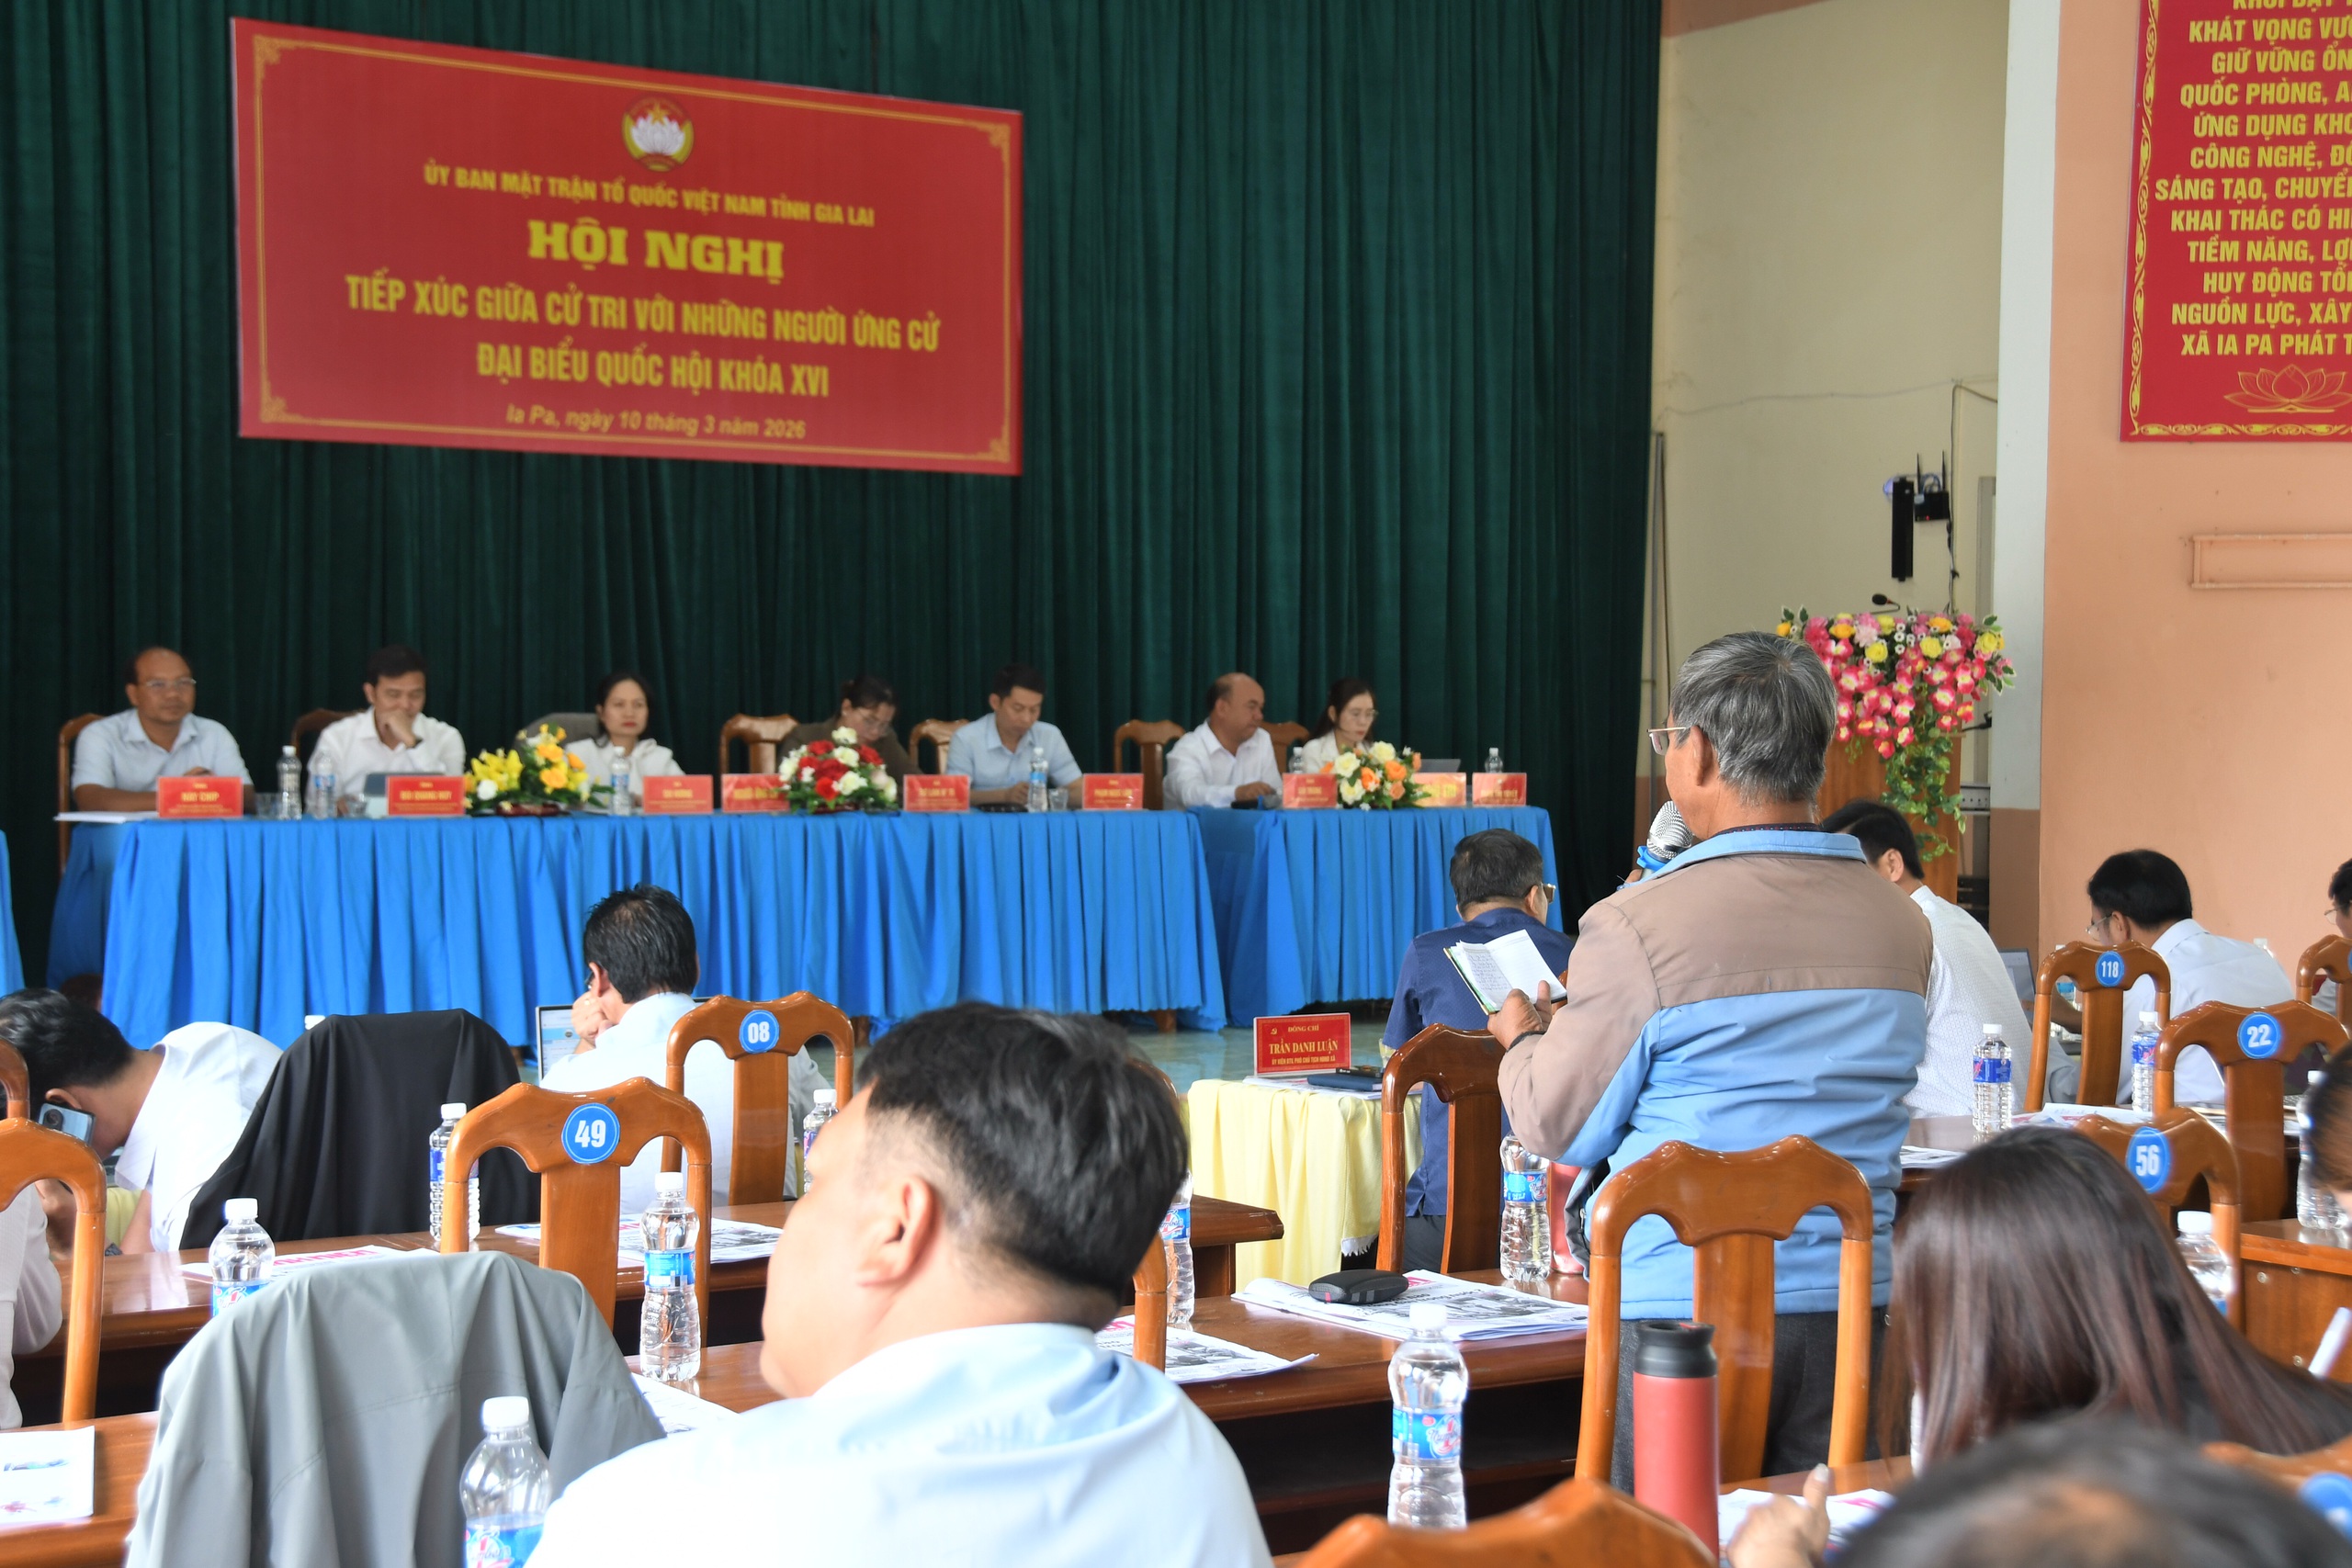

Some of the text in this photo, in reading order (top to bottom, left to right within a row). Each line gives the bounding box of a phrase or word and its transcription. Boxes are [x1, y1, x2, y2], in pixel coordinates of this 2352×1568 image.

[2189, 15, 2245, 42] KHÁT
[2253, 18, 2312, 46] VỌNG
[2211, 47, 2251, 74] GIỮ
[2256, 47, 2315, 73] VỮNG
[2180, 75, 2239, 108] QUỐC
[2246, 77, 2328, 106] PHÒNG,
[2194, 111, 2239, 138] ỨNG
[2246, 114, 2307, 141] DỤNG
[2190, 142, 2251, 169] CÔNG
[2257, 141, 2324, 172] NGHỆ,
[424, 157, 450, 186] ỦY
[455, 166, 496, 191] BAN
[548, 175, 597, 204] TRẬN
[628, 181, 678, 209] QUỐC
[682, 187, 720, 216] VIỆT
[724, 194, 766, 217] NAM
[814, 202, 844, 224] GIA
[848, 206, 875, 228] LAI
[2154, 175, 2215, 201] SÁNG
[2222, 177, 2267, 204] TẠO,
[2170, 209, 2222, 231] KHAI
[2229, 204, 2285, 231] THÁC
[2291, 204, 2322, 231] CÓ
[527, 216, 785, 286] HỘI NGHỊ
[2188, 233, 2240, 263] TIỀM
[2246, 235, 2315, 265] NĂNG,
[2203, 271, 2246, 294] HUY
[2252, 266, 2313, 298] ĐỘNG
[345, 266, 406, 312] TIẾP
[413, 275, 469, 318] XÚC
[475, 281, 539, 323] GIỮA
[545, 282, 583, 326] CỬ
[587, 294, 628, 329] TRI
[682, 298, 767, 340] NHỮNG
[774, 305, 846, 345] NGƯỜI
[853, 309, 901, 350] ỨNG
[907, 310, 941, 353] CỬ
[2171, 295, 2247, 325] NGUỒN
[2254, 300, 2302, 329] LỰC,
[2181, 330, 2211, 355] XÃ
[2217, 333, 2239, 355] IA
[2245, 333, 2274, 355] PA
[2279, 329, 2337, 355] PHÁT
[476, 335, 829, 398] ĐẠI BIỂU QUỐC HỘI KHÓA XVI
[565, 408, 614, 433] ngày
[620, 411, 640, 430] 10
[646, 412, 699, 437] tháng
[704, 414, 715, 434] 3
[719, 417, 759, 436] năm
[763, 418, 806, 439] 2026
[2101, 961, 2119, 978] 118
[747, 1021, 770, 1044] 08
[1269, 1038, 1339, 1055] TRẦN DANH LUẬN
[2246, 1023, 2271, 1048] 22
[574, 1119, 606, 1148] 49
[2135, 1145, 2160, 1177] 56
